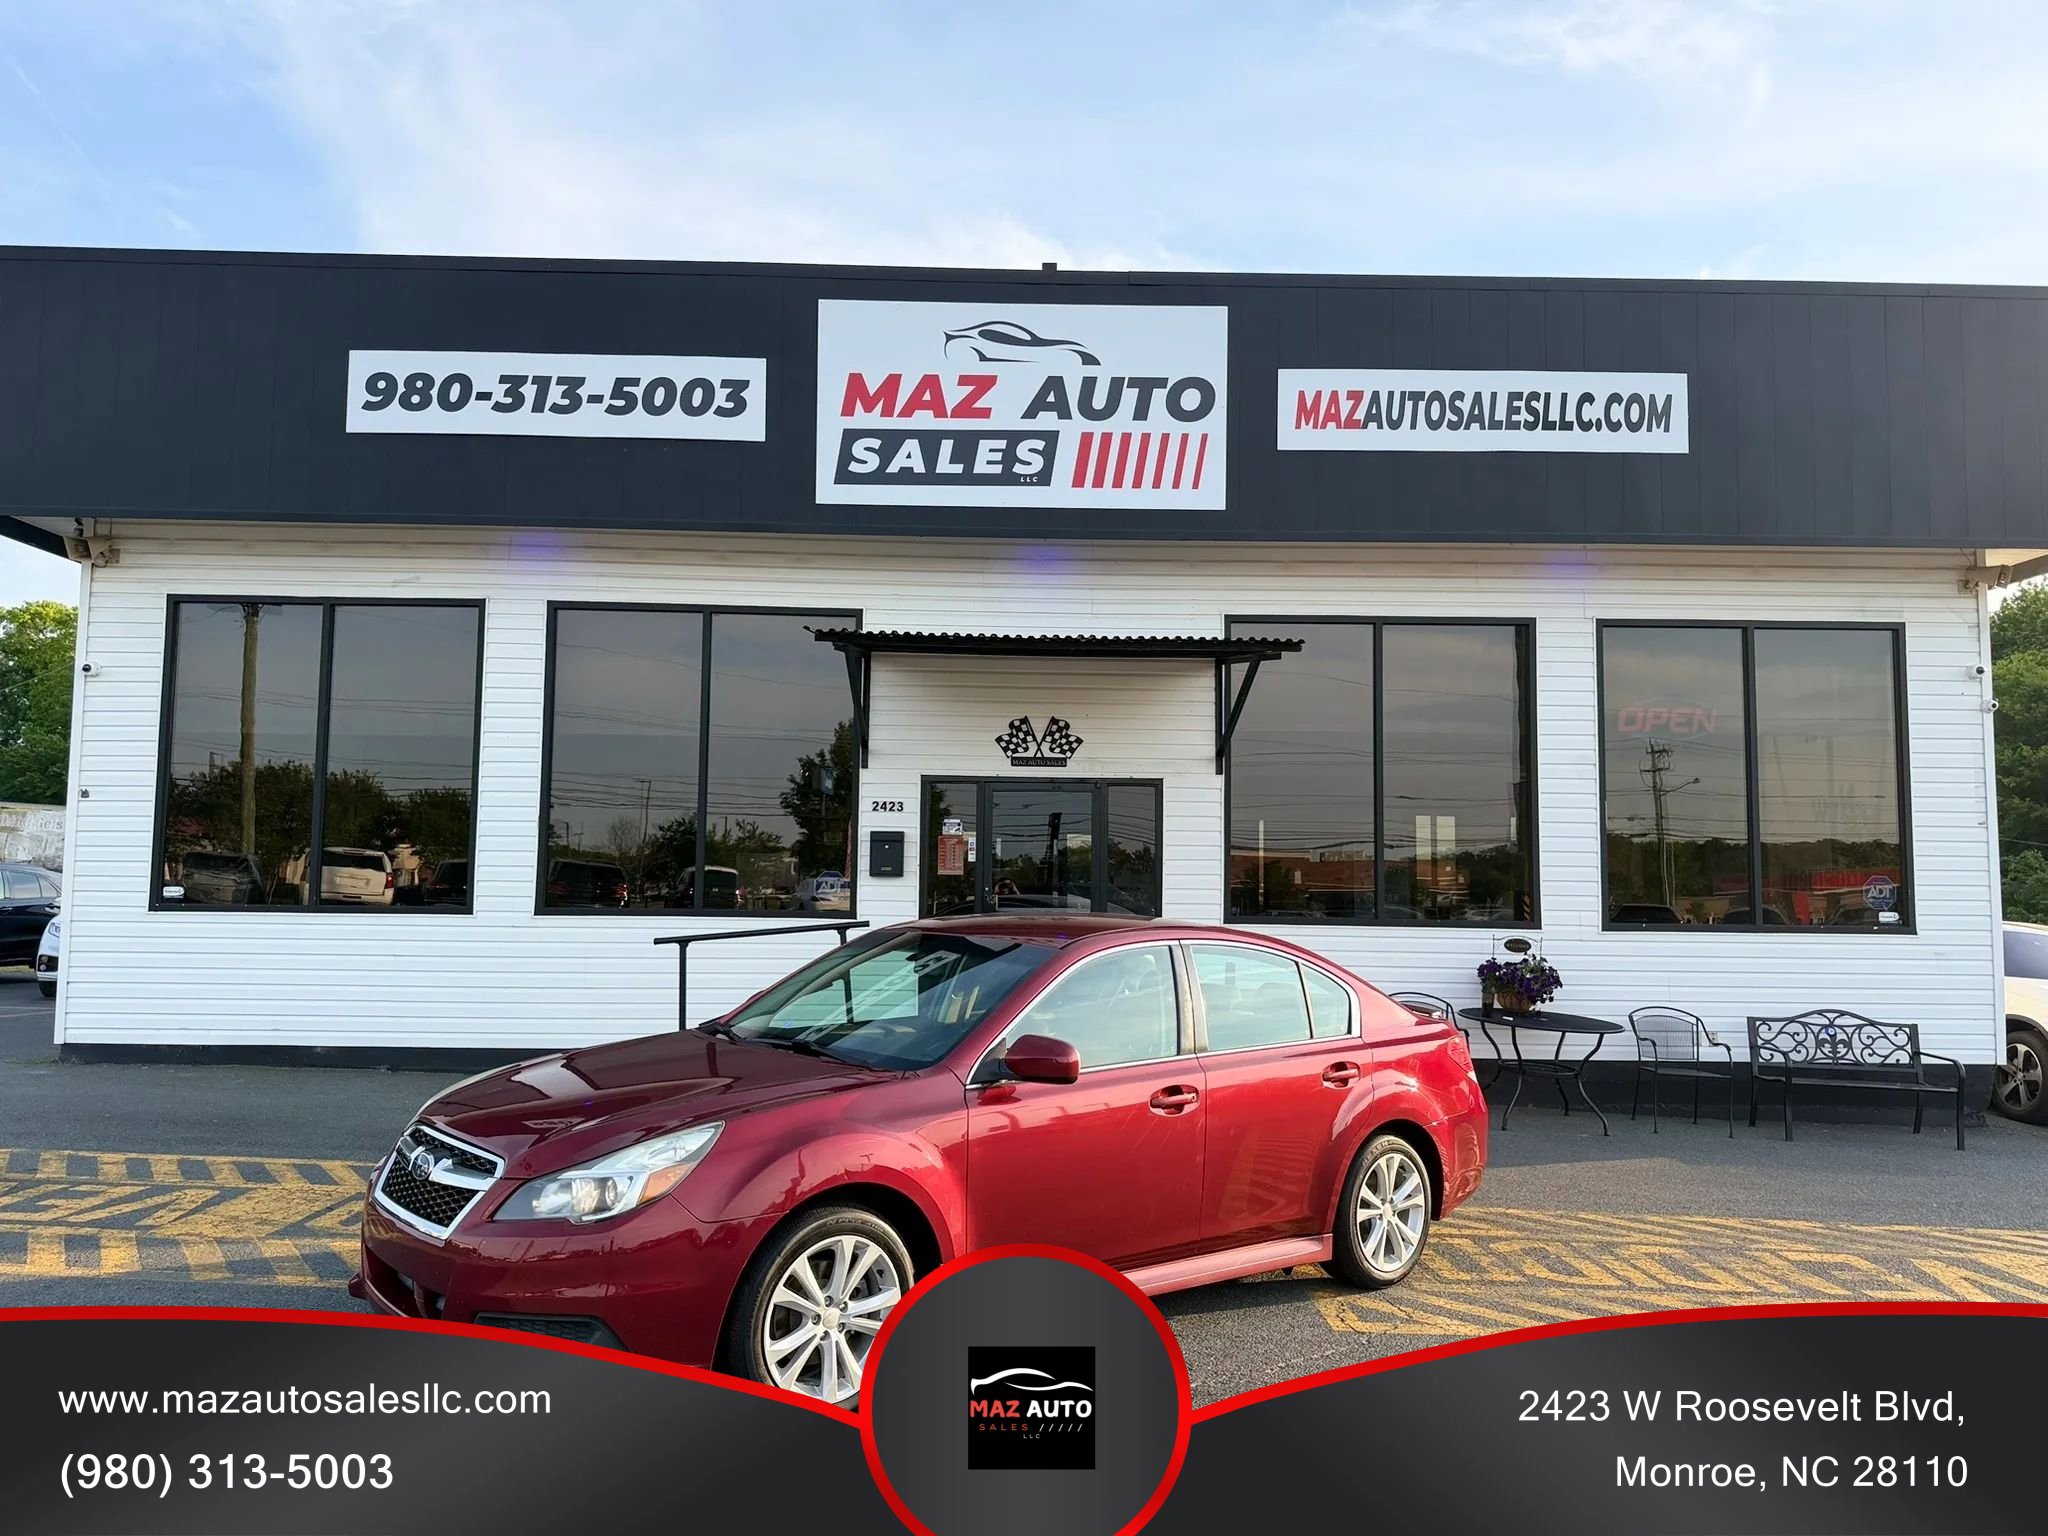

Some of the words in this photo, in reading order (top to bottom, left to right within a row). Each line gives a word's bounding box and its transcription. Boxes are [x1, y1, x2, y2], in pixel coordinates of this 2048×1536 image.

[361, 371, 751, 419] 980-313-5003
[840, 372, 998, 420] MAZ
[1021, 375, 1216, 422] AUTO
[1294, 389, 1673, 434] MAZAUTOSALESLLC.COM
[847, 437, 1046, 475] SALES
[1617, 706, 1718, 734] OPEN
[871, 800, 904, 812] 2423
[818, 880, 845, 893] ADT
[1867, 884, 1893, 898] ADT
